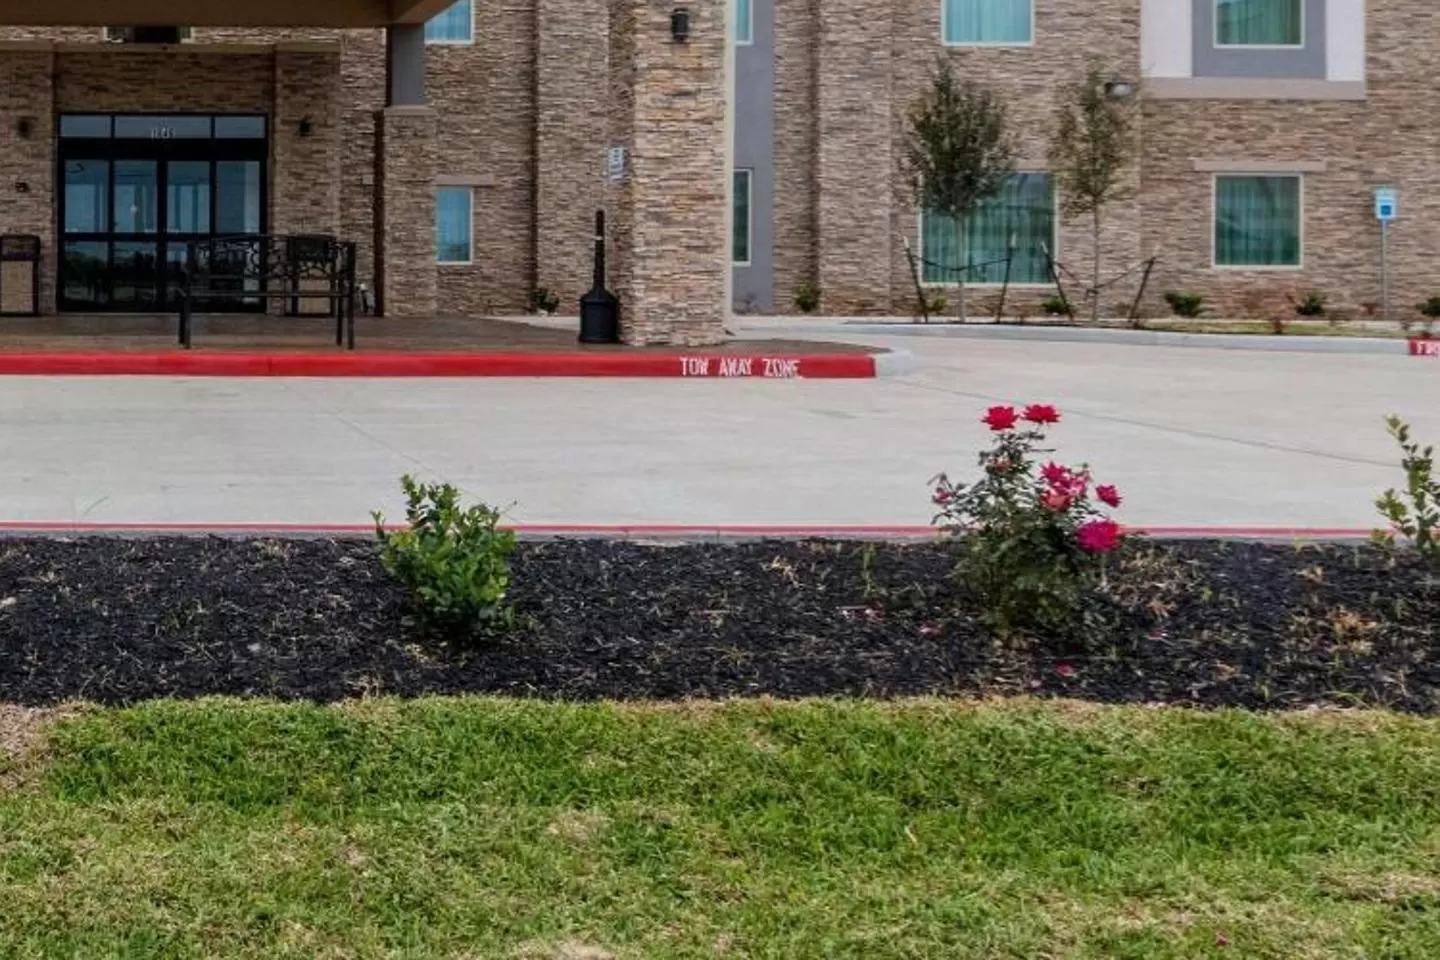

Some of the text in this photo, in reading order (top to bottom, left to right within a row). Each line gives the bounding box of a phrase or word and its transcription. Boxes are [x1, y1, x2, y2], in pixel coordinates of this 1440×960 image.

[679, 355, 801, 378] TOW AWAY ZONE
